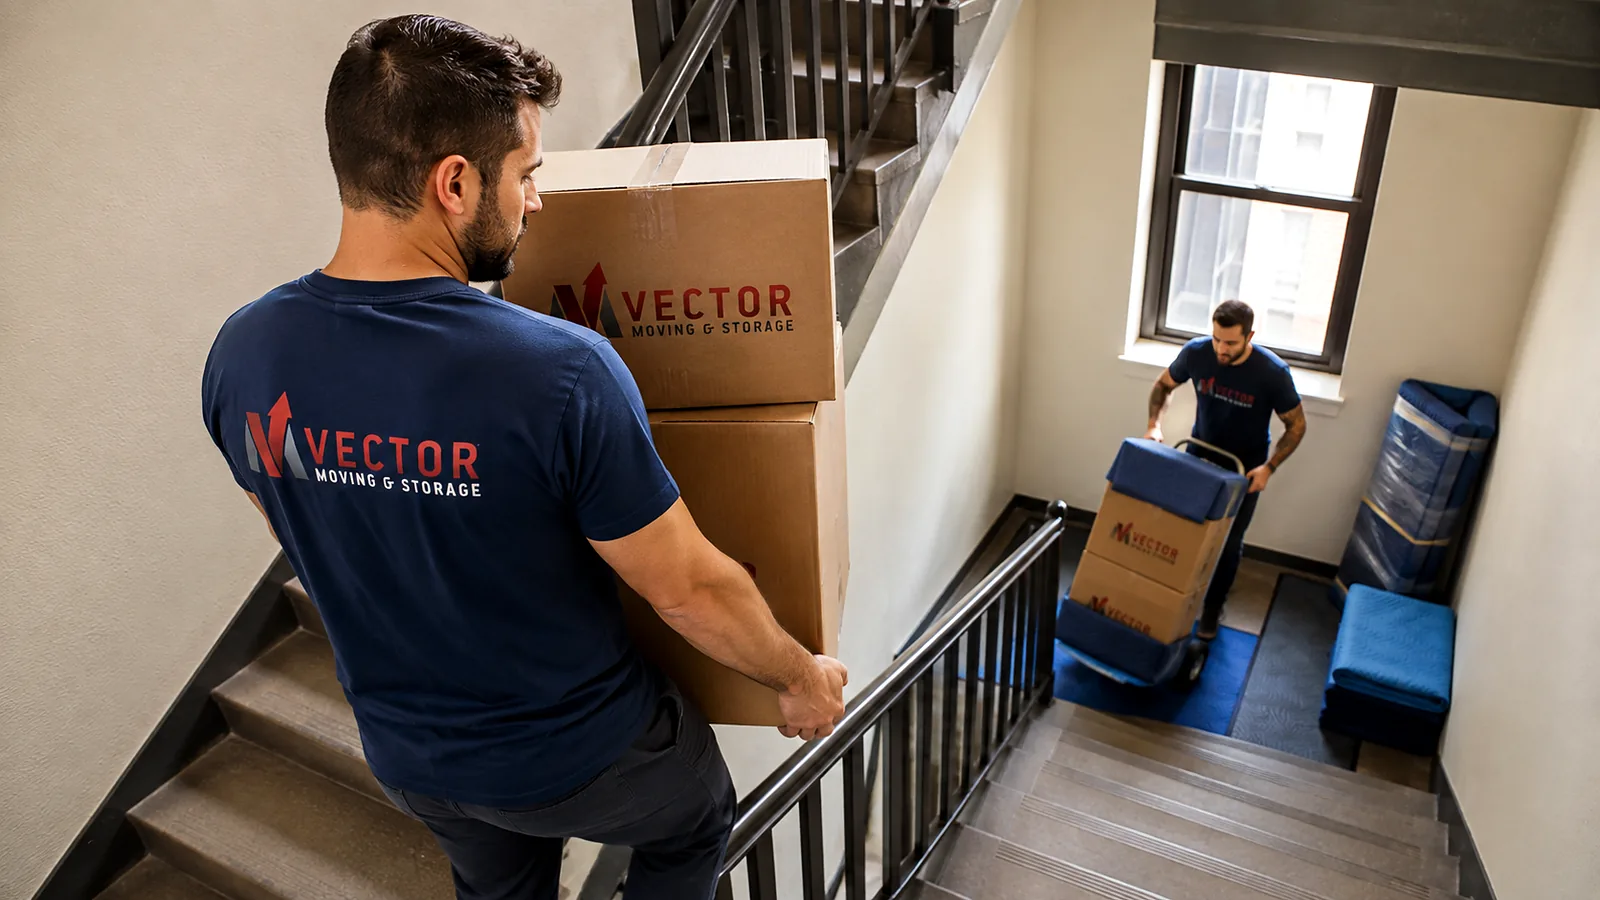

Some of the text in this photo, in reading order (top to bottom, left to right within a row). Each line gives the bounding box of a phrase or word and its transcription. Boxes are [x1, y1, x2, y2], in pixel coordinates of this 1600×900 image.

[621, 284, 793, 322] VECTOR
[632, 319, 794, 337] MOVING & STORAGE
[303, 427, 479, 479] VECTOR
[314, 467, 482, 497] MOVING & STORAGE
[1132, 531, 1179, 560] VECTOR
